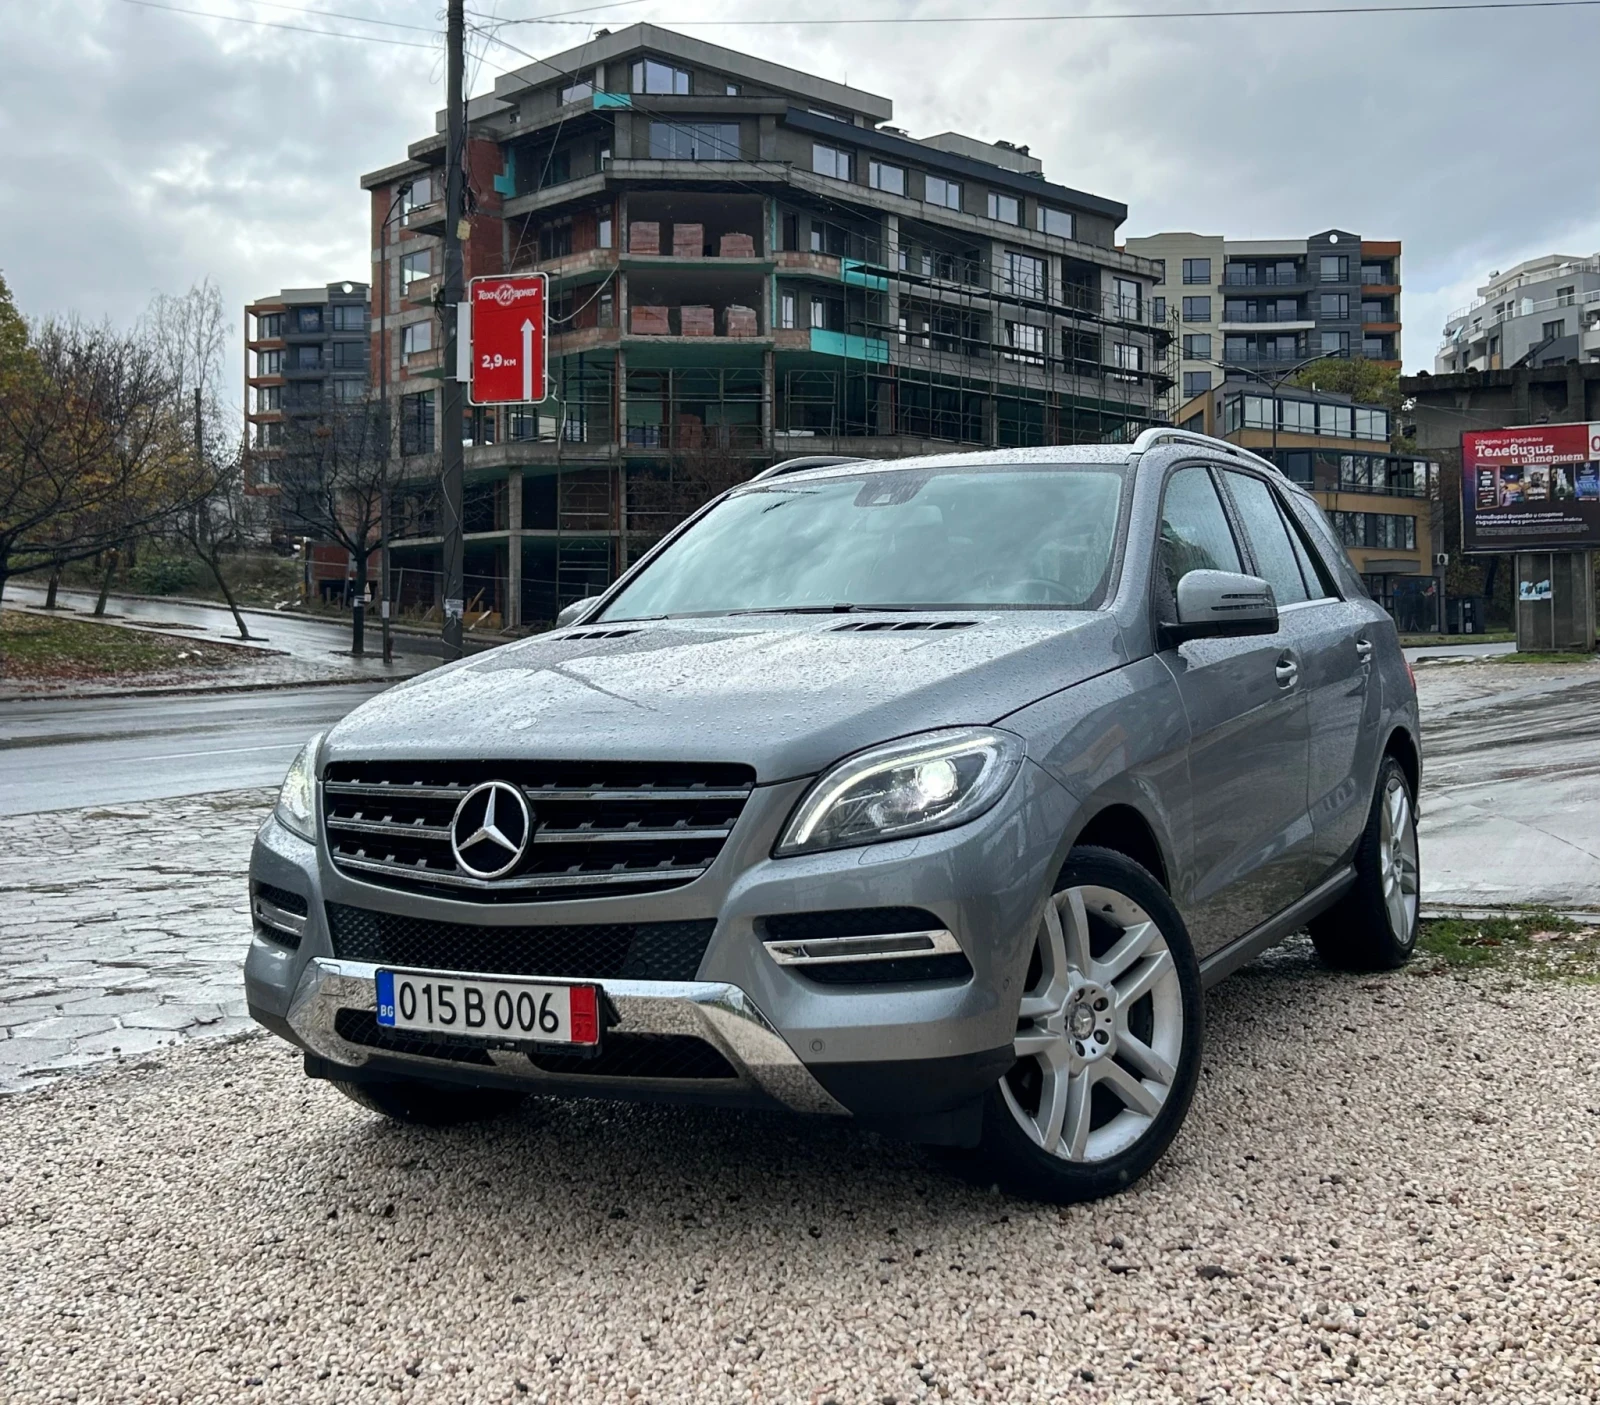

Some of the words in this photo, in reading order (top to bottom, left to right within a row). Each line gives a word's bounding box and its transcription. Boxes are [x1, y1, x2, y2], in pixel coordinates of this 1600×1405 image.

[482, 354, 502, 369] 2,9
[1475, 443, 1555, 457] Телевизия
[1511, 456, 1519, 464] и
[1521, 453, 1584, 464] интернет
[380, 1004, 394, 1018] BG
